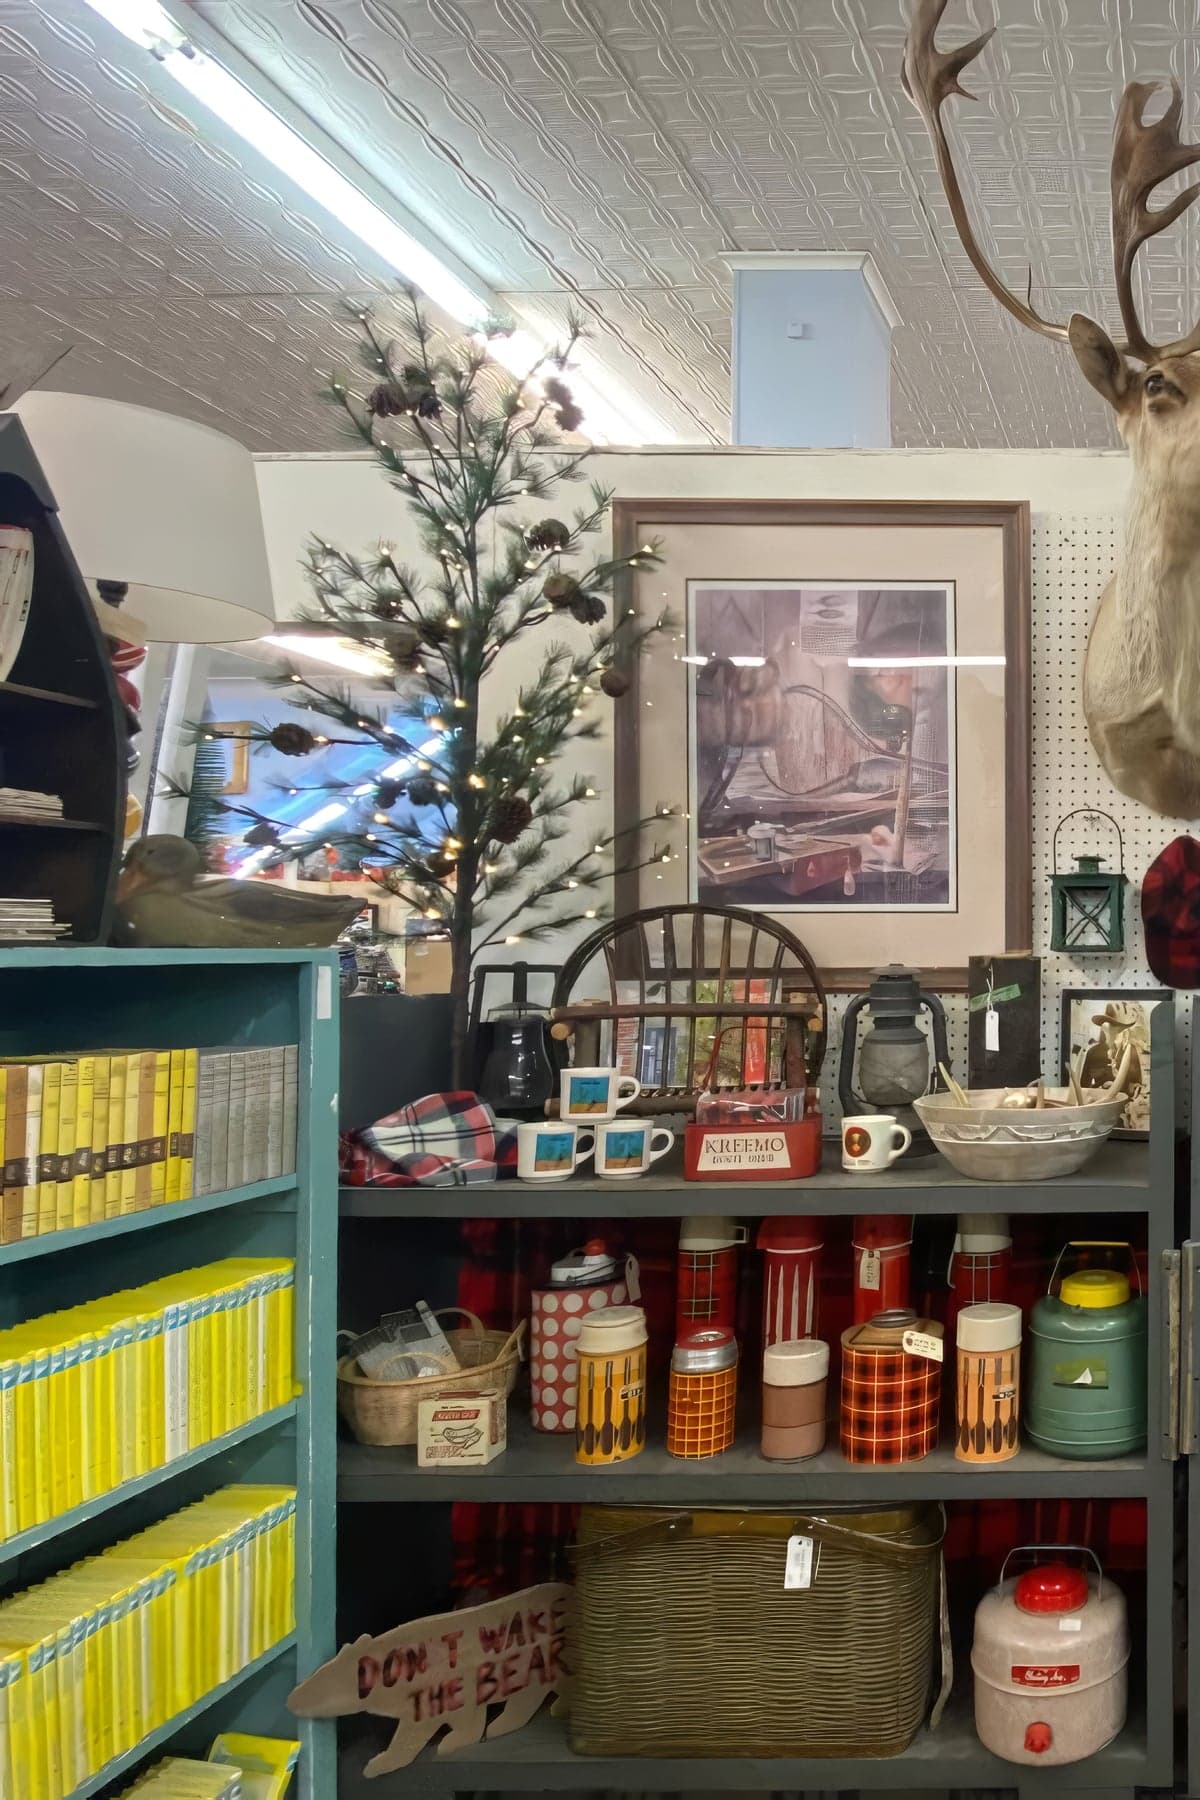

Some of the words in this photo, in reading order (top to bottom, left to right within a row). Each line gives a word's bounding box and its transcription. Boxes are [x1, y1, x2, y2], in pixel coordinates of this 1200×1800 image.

[705, 1137, 785, 1153] KREEMO
[357, 1630, 464, 1699] DON'T
[478, 1597, 567, 1654] WAKE
[408, 1676, 464, 1722] THE
[476, 1636, 573, 1706] BEAR
